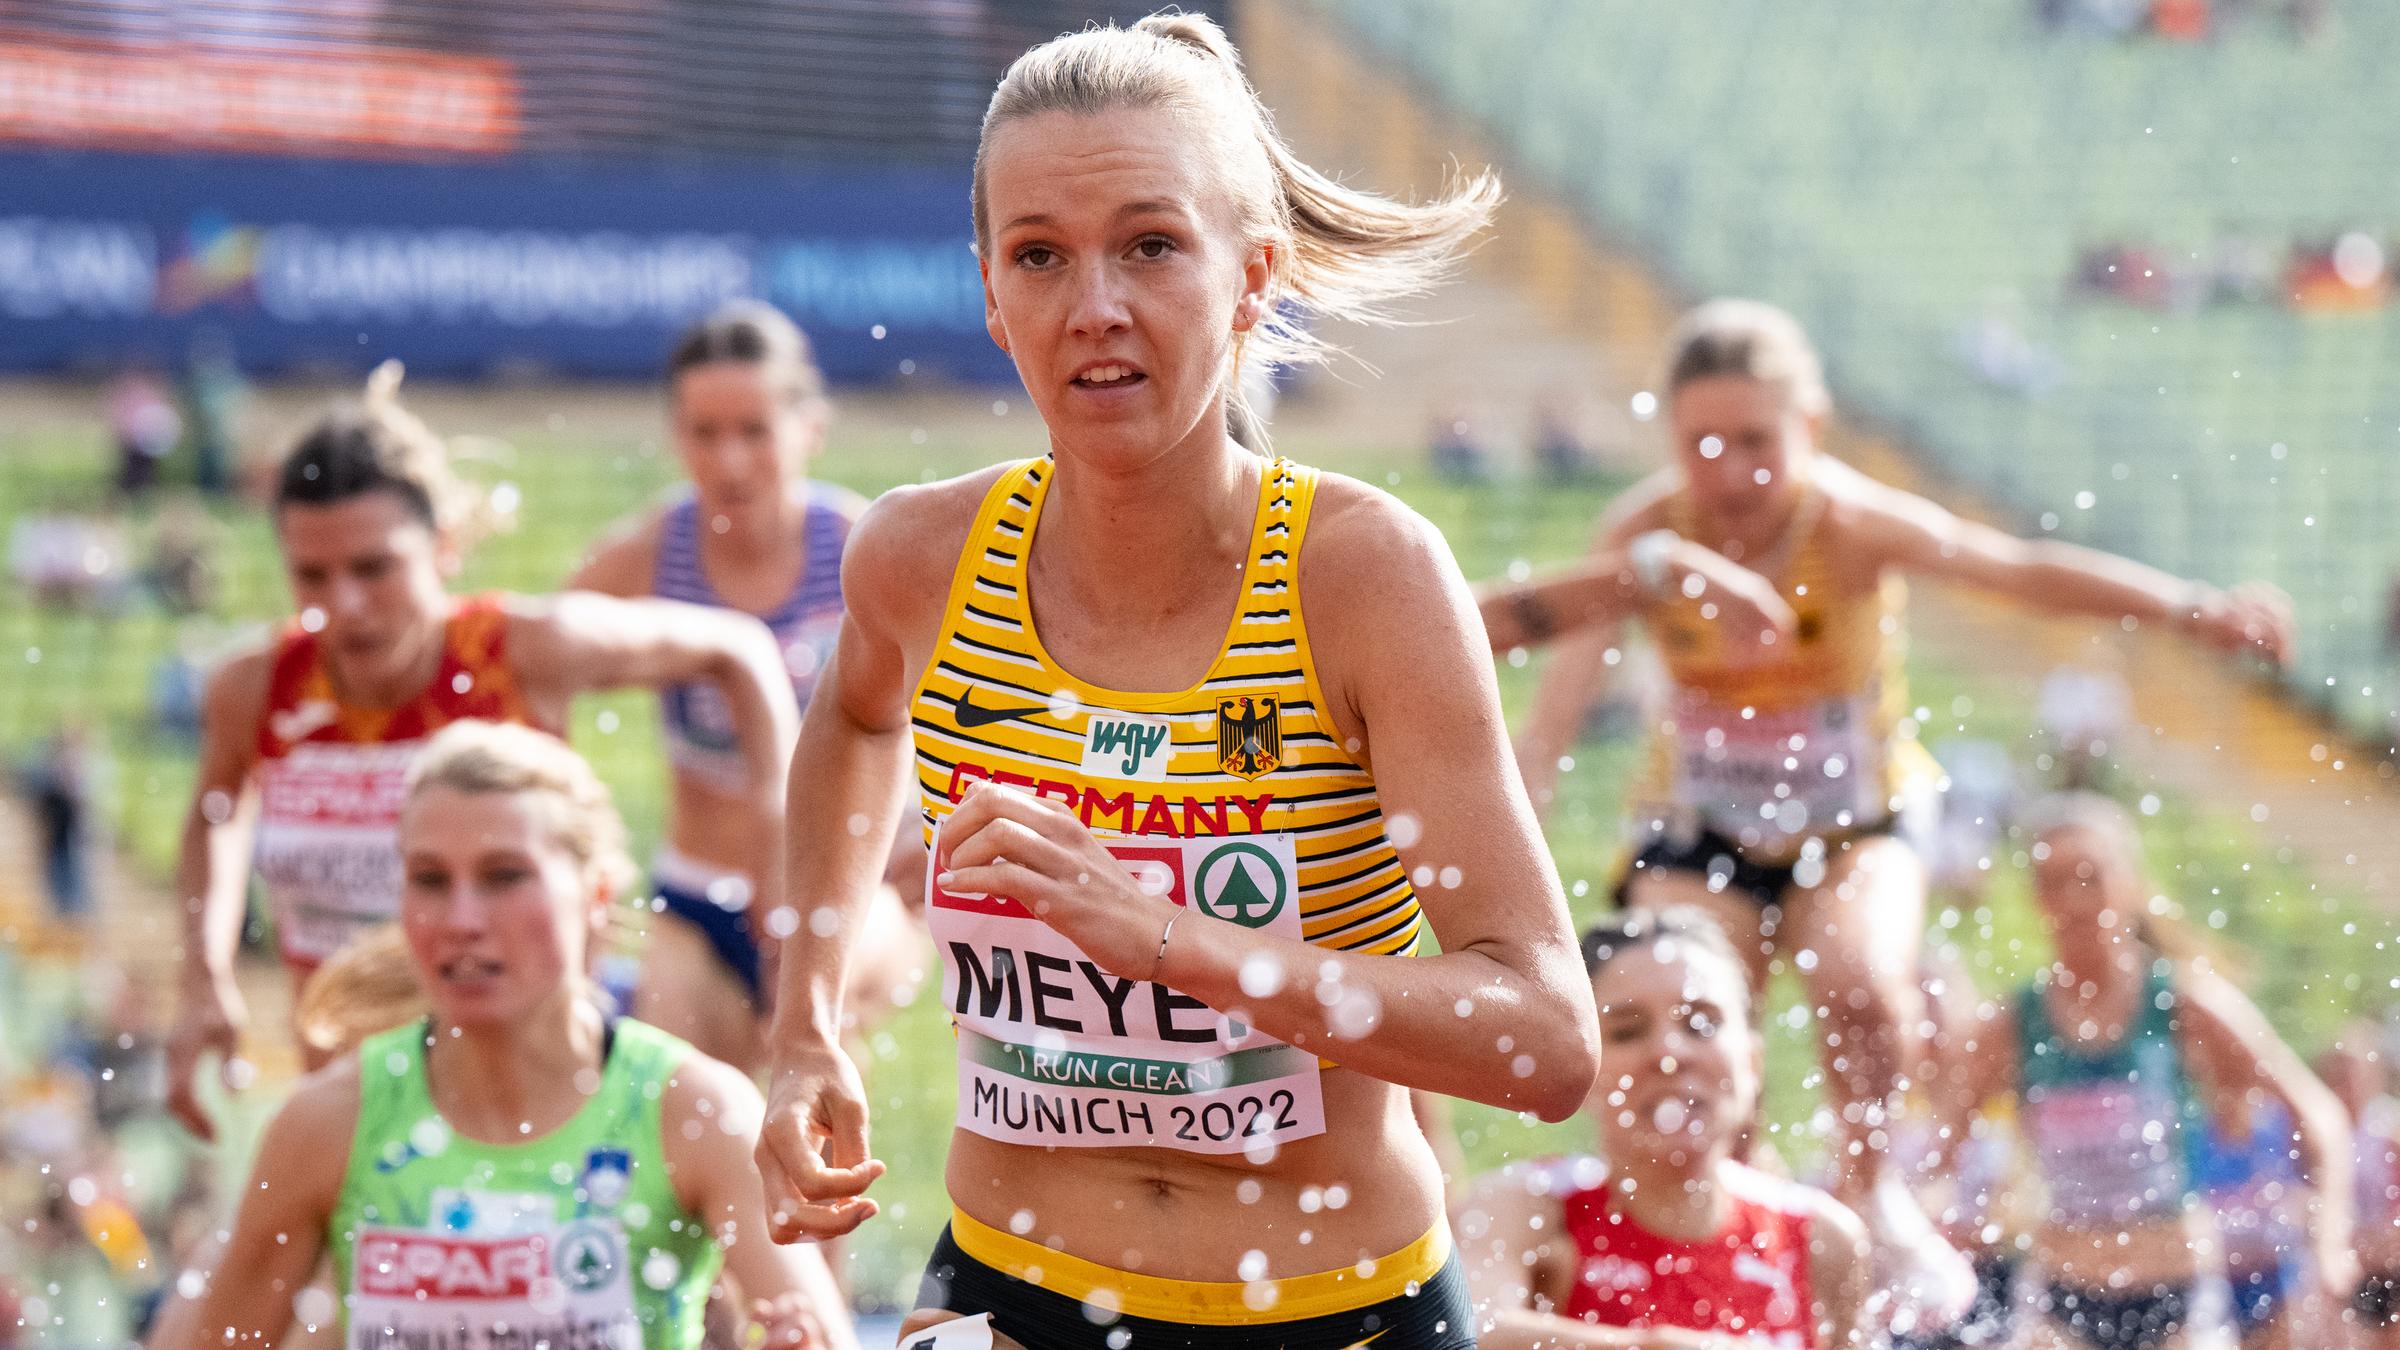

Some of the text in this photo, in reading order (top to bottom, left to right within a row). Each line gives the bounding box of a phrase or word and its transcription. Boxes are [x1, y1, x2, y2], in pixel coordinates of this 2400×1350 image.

[948, 761, 1275, 839] GRMANY
[948, 941, 1247, 1043] MEYE
[1033, 1052, 1098, 1085] RUN
[975, 1076, 1298, 1141] MUNICH 2022
